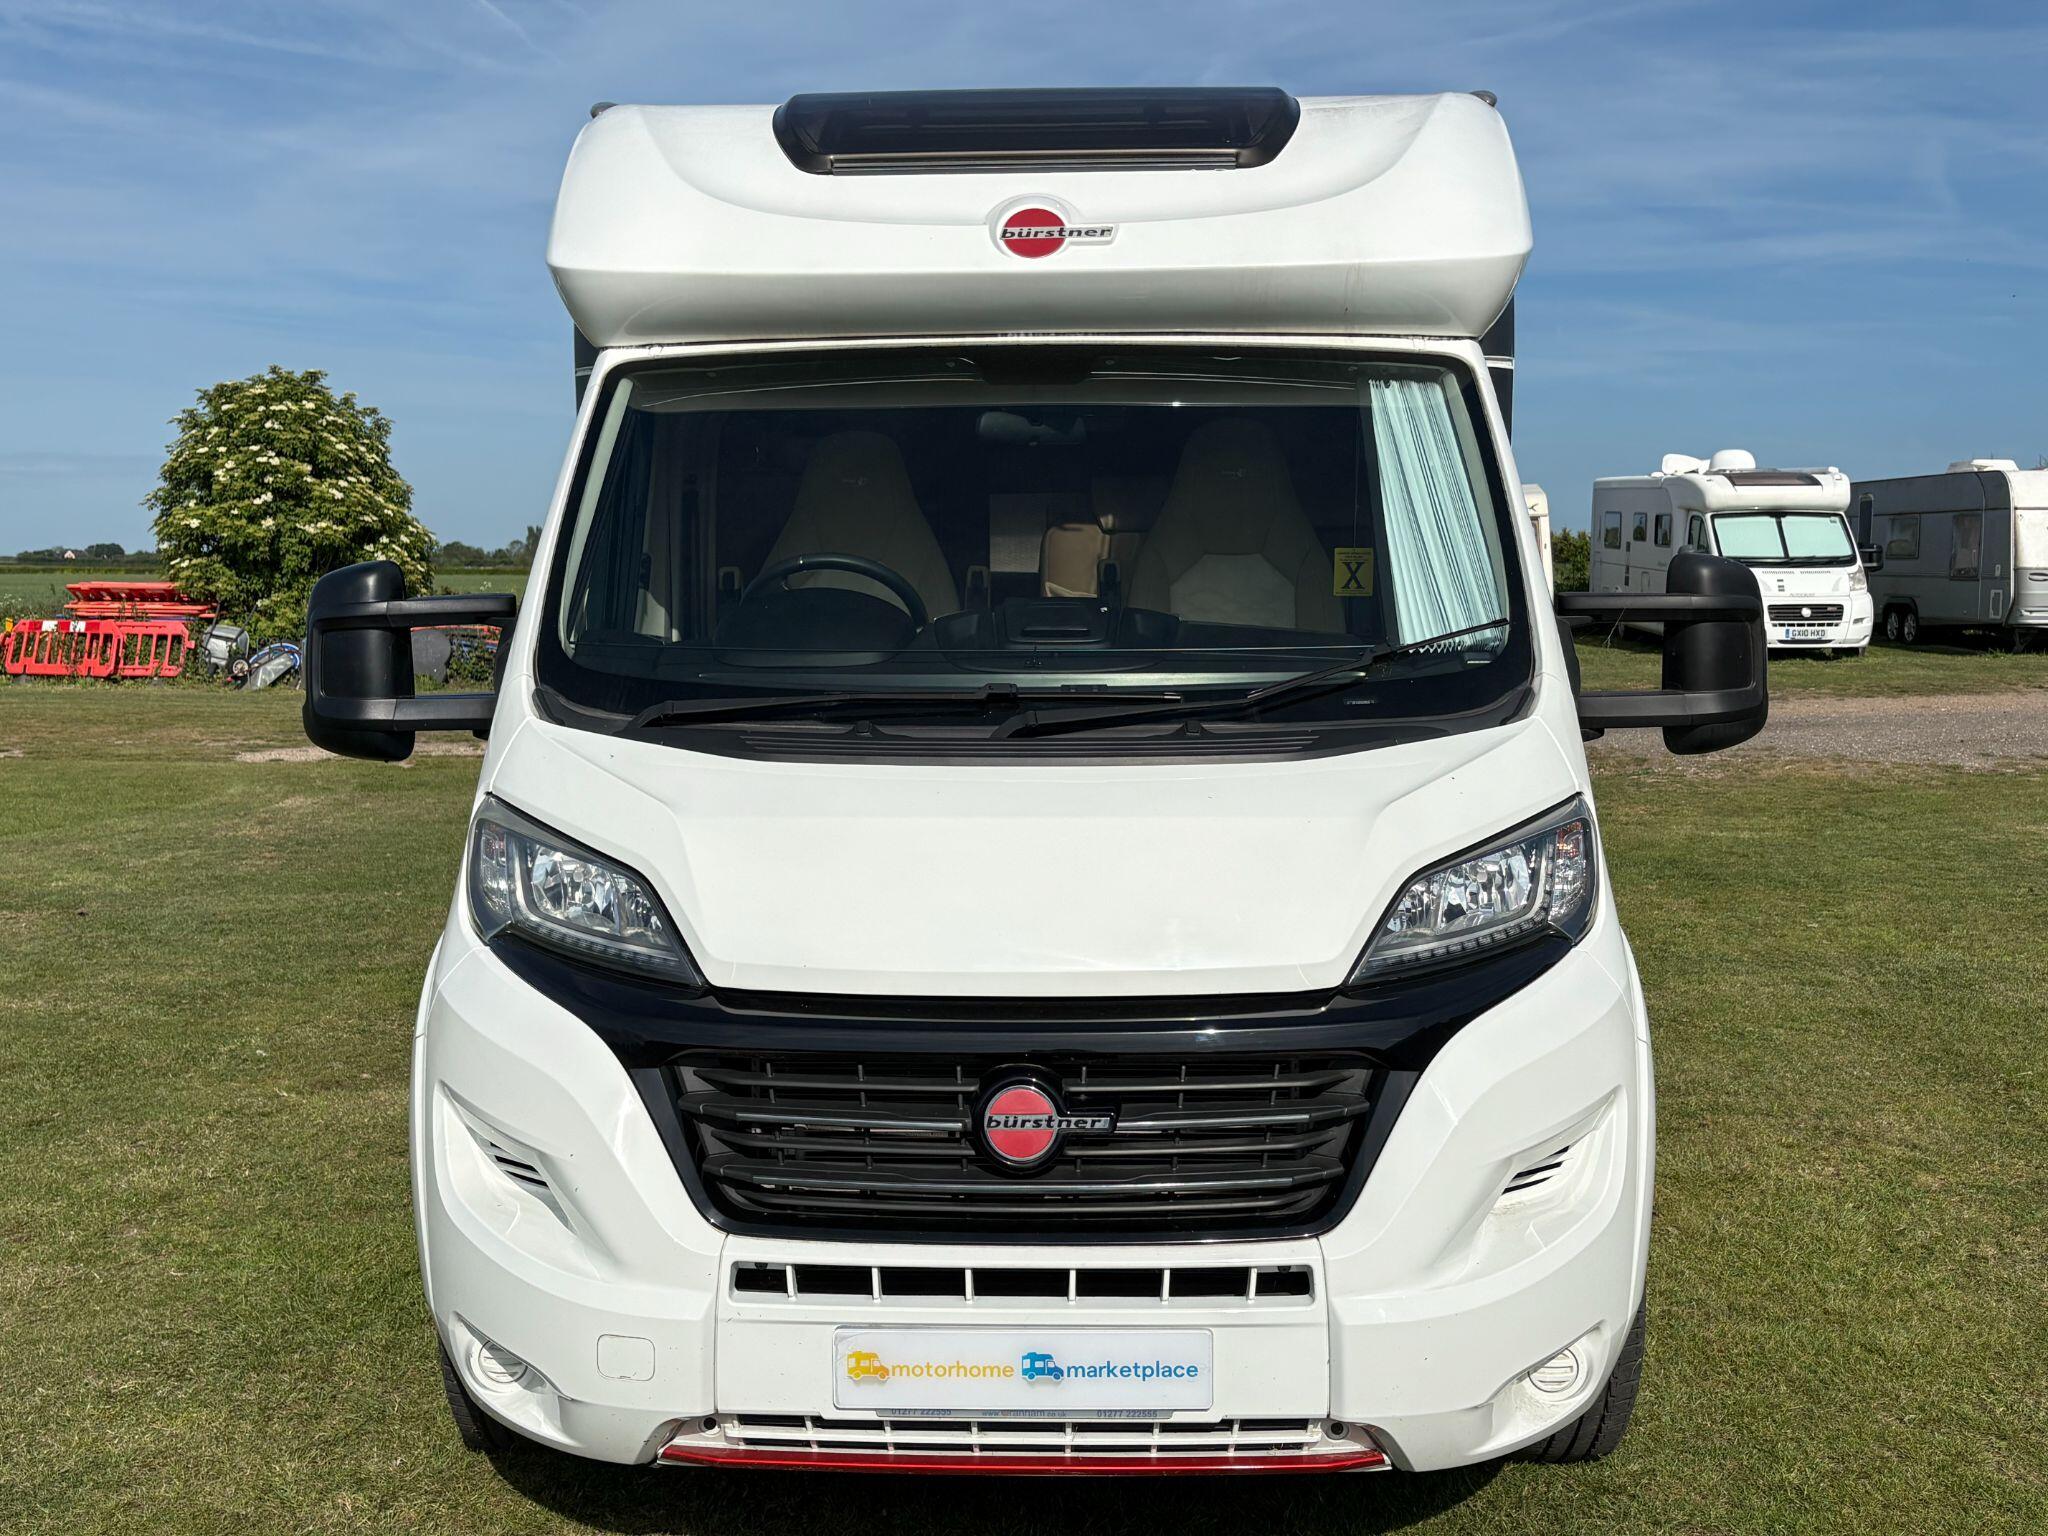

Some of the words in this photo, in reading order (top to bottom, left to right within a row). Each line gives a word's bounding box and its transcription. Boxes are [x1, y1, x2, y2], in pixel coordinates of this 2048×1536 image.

[1001, 226, 1111, 239] bürstner
[1341, 561, 1365, 589] X
[986, 1115, 1101, 1129] bürstner
[891, 1360, 1014, 1377] motorhome
[1066, 1360, 1199, 1381] marketplace
